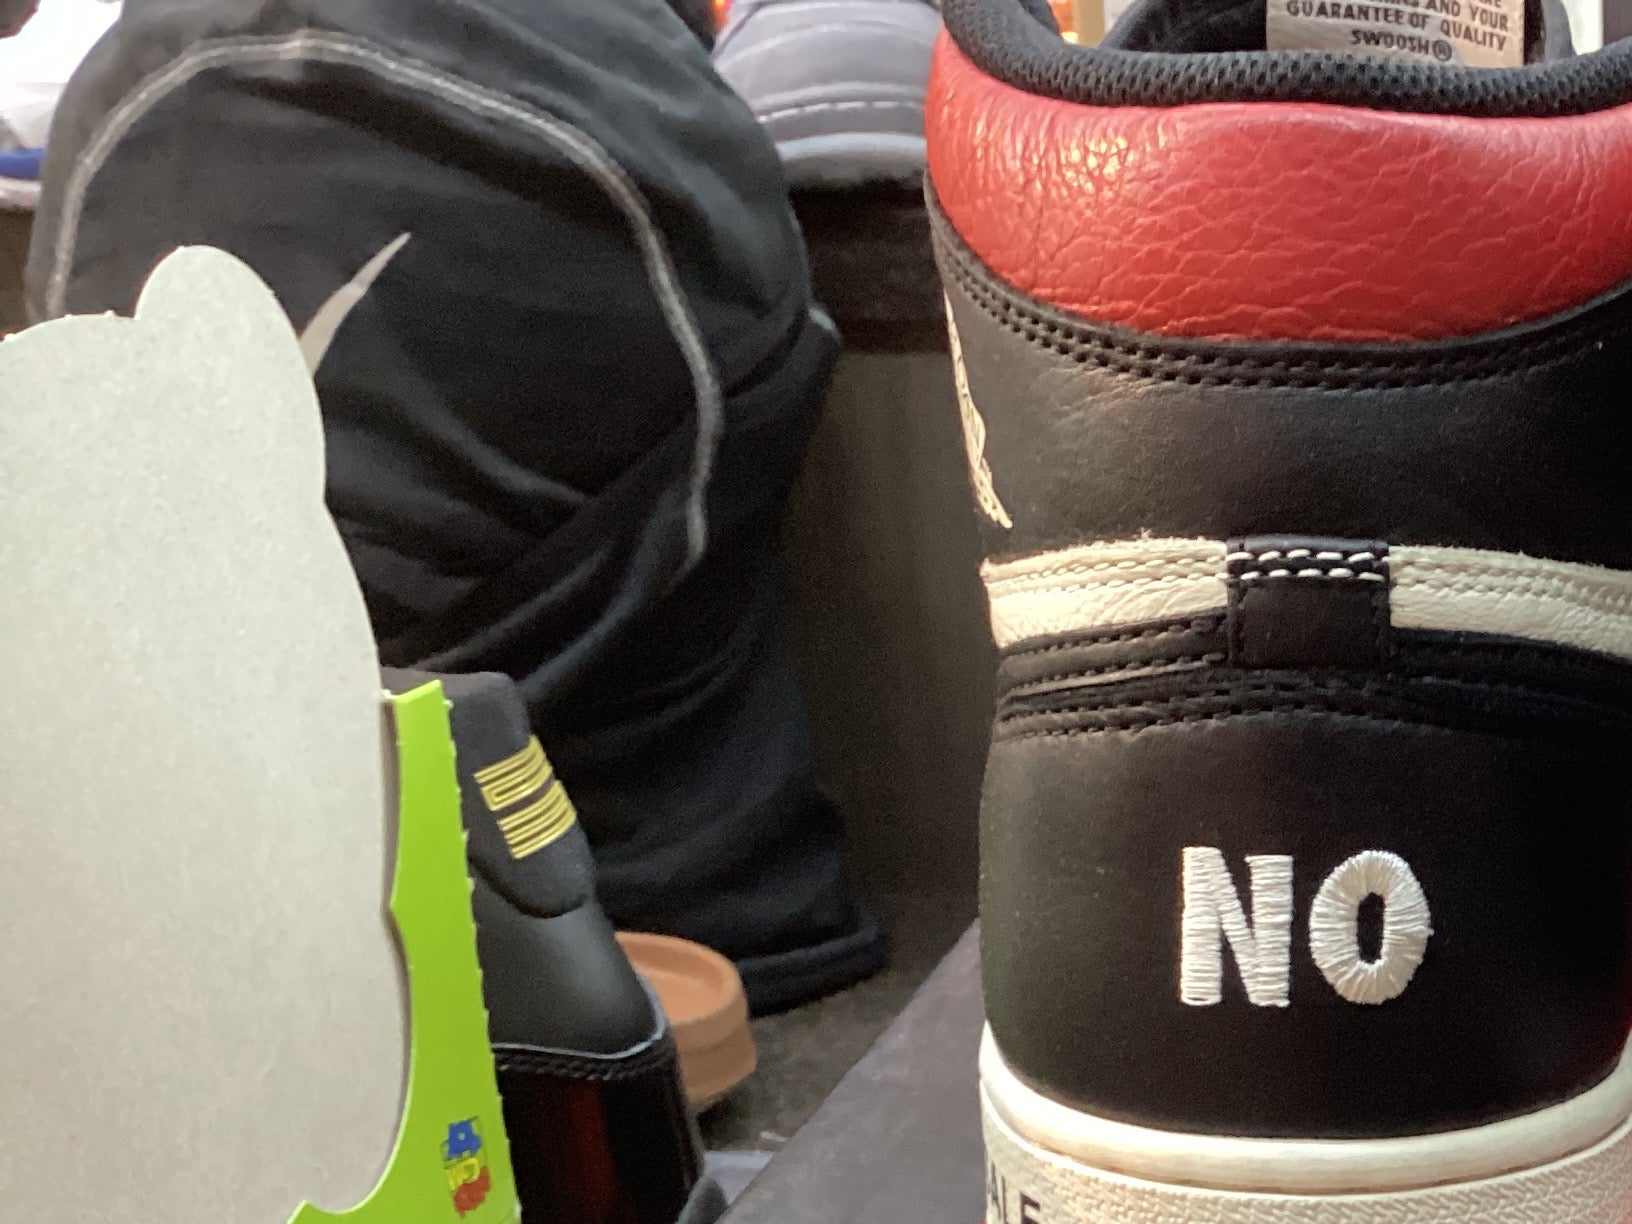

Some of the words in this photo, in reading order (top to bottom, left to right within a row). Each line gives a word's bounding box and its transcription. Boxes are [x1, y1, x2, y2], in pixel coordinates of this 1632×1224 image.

[1286, 0, 1402, 27] GUARANTEE
[1408, 13, 1430, 29] OF
[1440, 20, 1507, 51] QUALITY
[1469, 8, 1509, 31] YOUR
[1179, 846, 1434, 1008] NO
